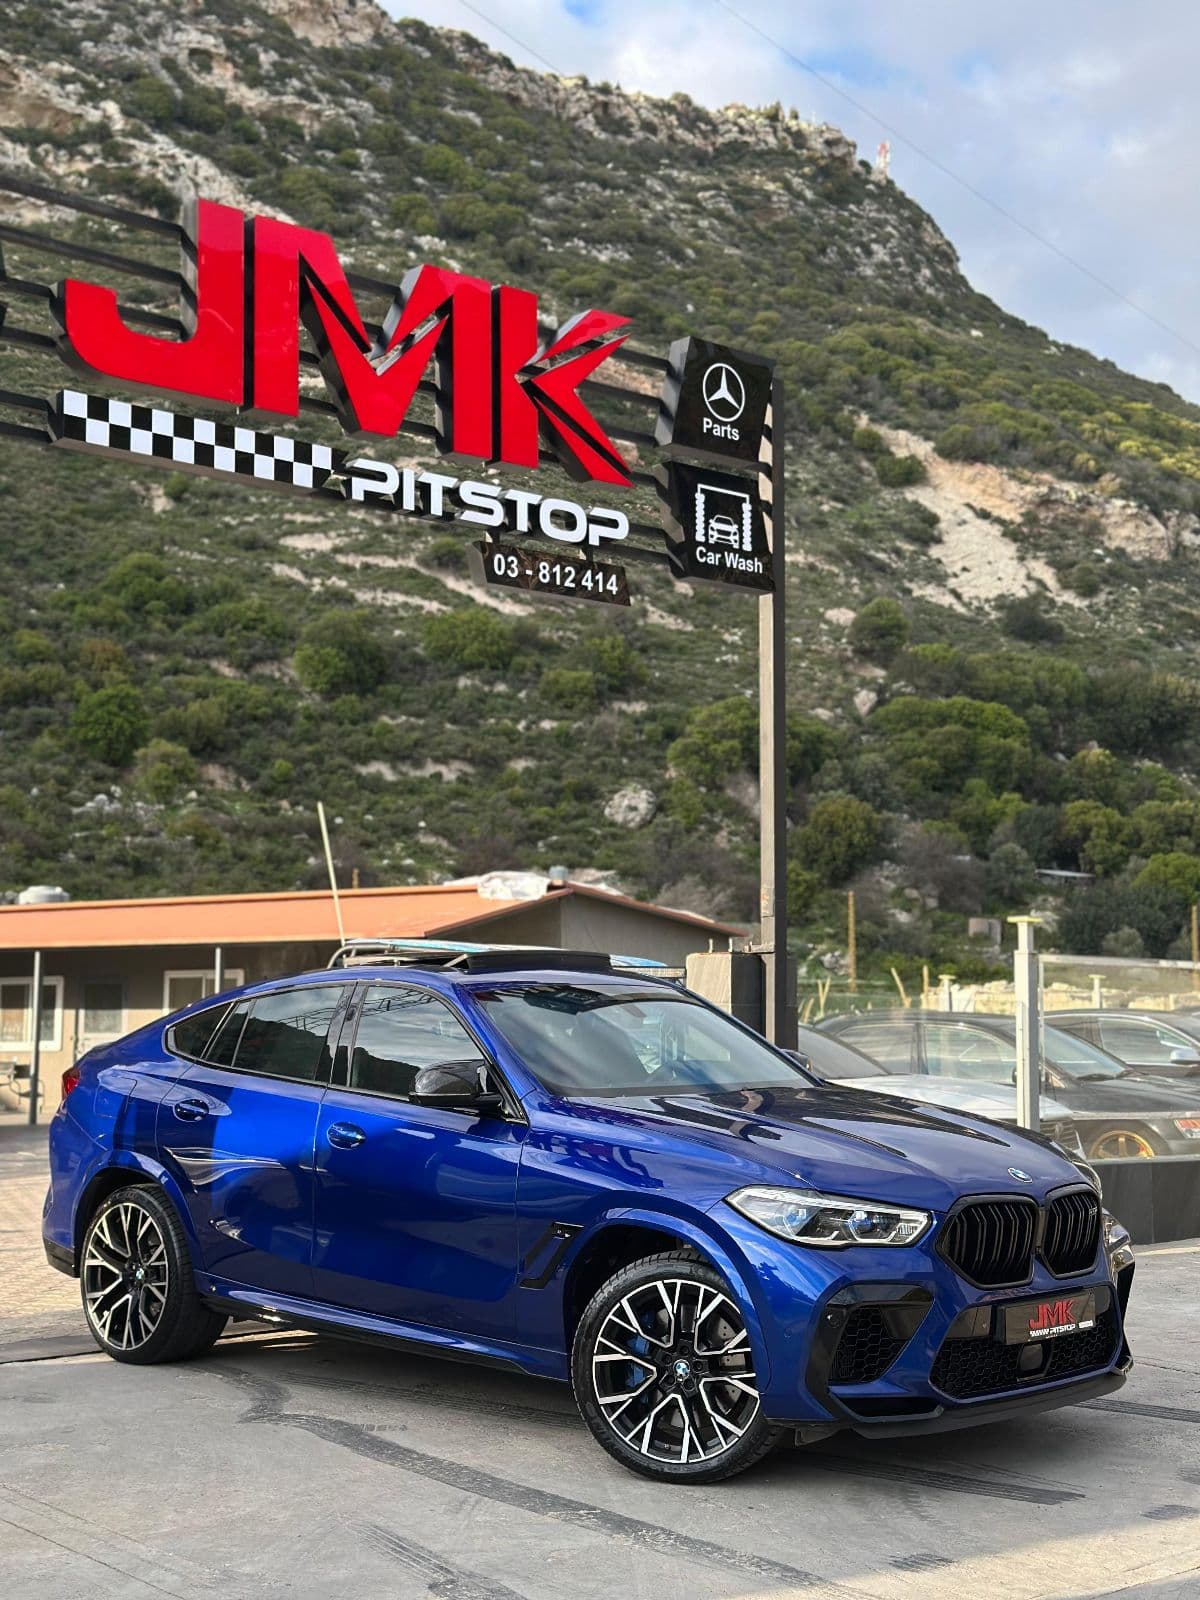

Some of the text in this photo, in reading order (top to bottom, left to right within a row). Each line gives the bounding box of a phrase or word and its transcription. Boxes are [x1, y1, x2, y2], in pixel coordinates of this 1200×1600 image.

[65, 198, 634, 489] JMK
[703, 417, 740, 441] Parts
[351, 458, 630, 546] PITSTOP
[493, 553, 519, 578] 03
[696, 546, 763, 574] Car Wash
[1029, 1299, 1076, 1329] JMK
